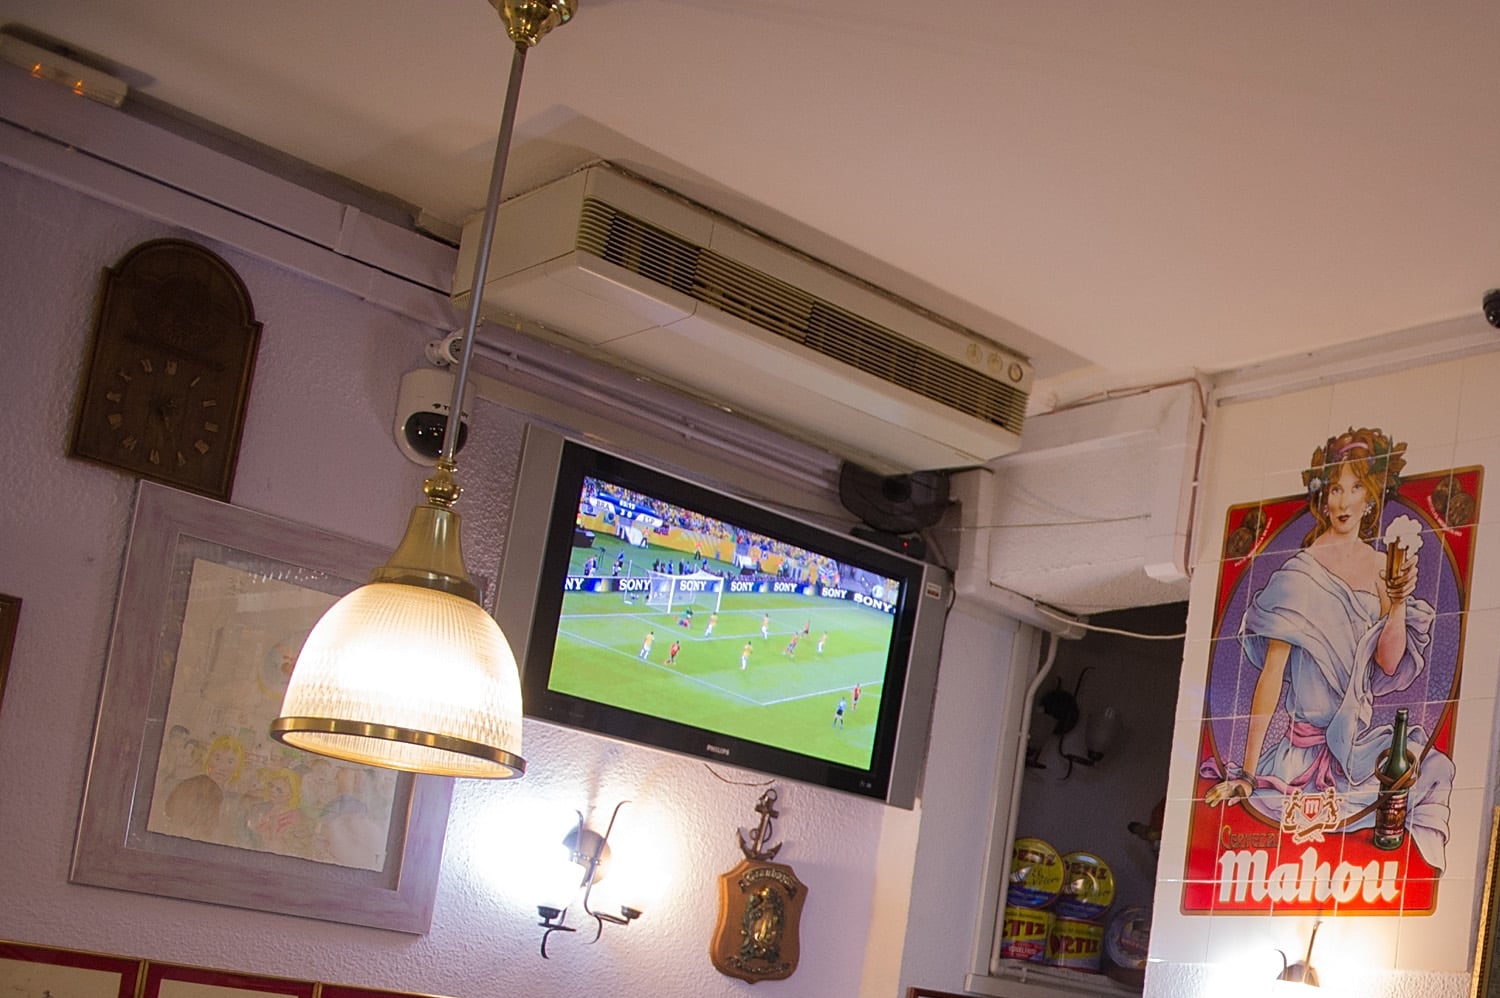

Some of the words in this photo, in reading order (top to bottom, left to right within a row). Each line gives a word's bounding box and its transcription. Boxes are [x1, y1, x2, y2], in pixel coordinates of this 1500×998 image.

[596, 500, 610, 511] BRA
[620, 578, 650, 591] SONY
[680, 580, 706, 592] SONY
[730, 580, 754, 592] SONY
[774, 582, 798, 592] SONY
[822, 586, 848, 599] SONY
[854, 592, 893, 614] SONY
[706, 744, 730, 755] PHILIPS
[1218, 846, 1401, 904] Mahou
